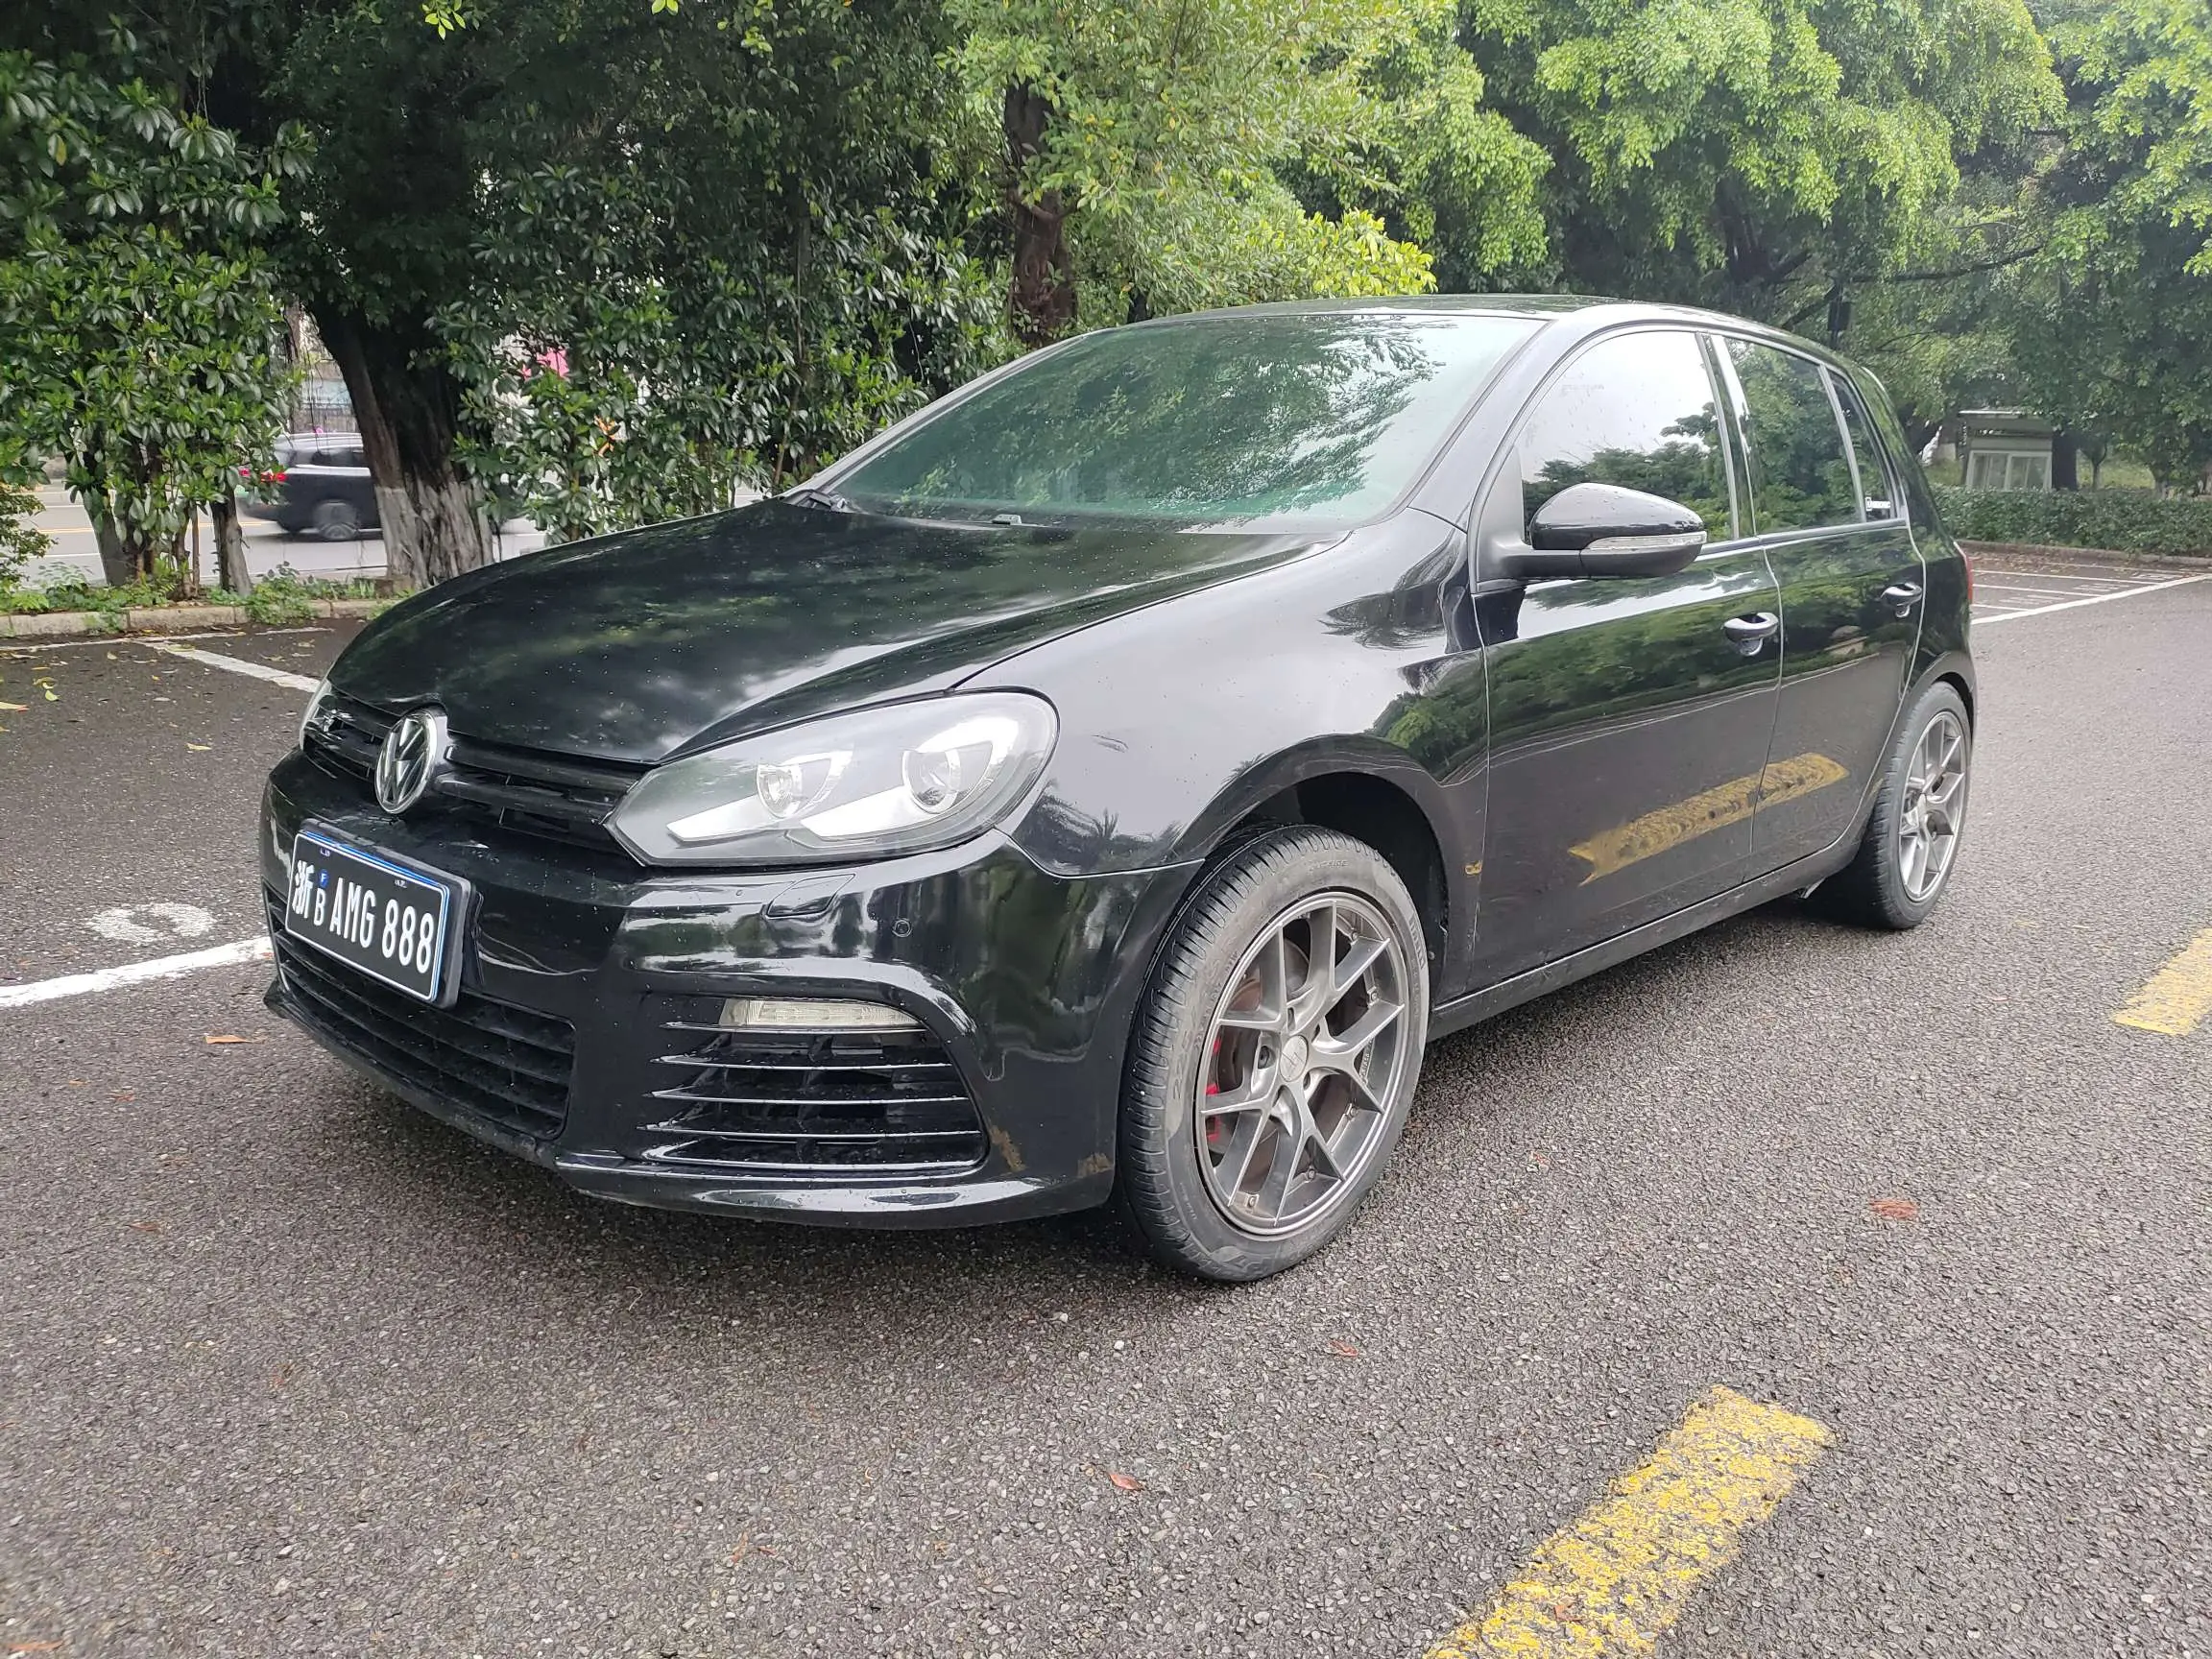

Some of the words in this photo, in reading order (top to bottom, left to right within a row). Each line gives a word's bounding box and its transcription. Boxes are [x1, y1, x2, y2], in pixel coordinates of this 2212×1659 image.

[374, 709, 439, 815] VW
[329, 877, 377, 949] AMG
[381, 899, 435, 974] 888
